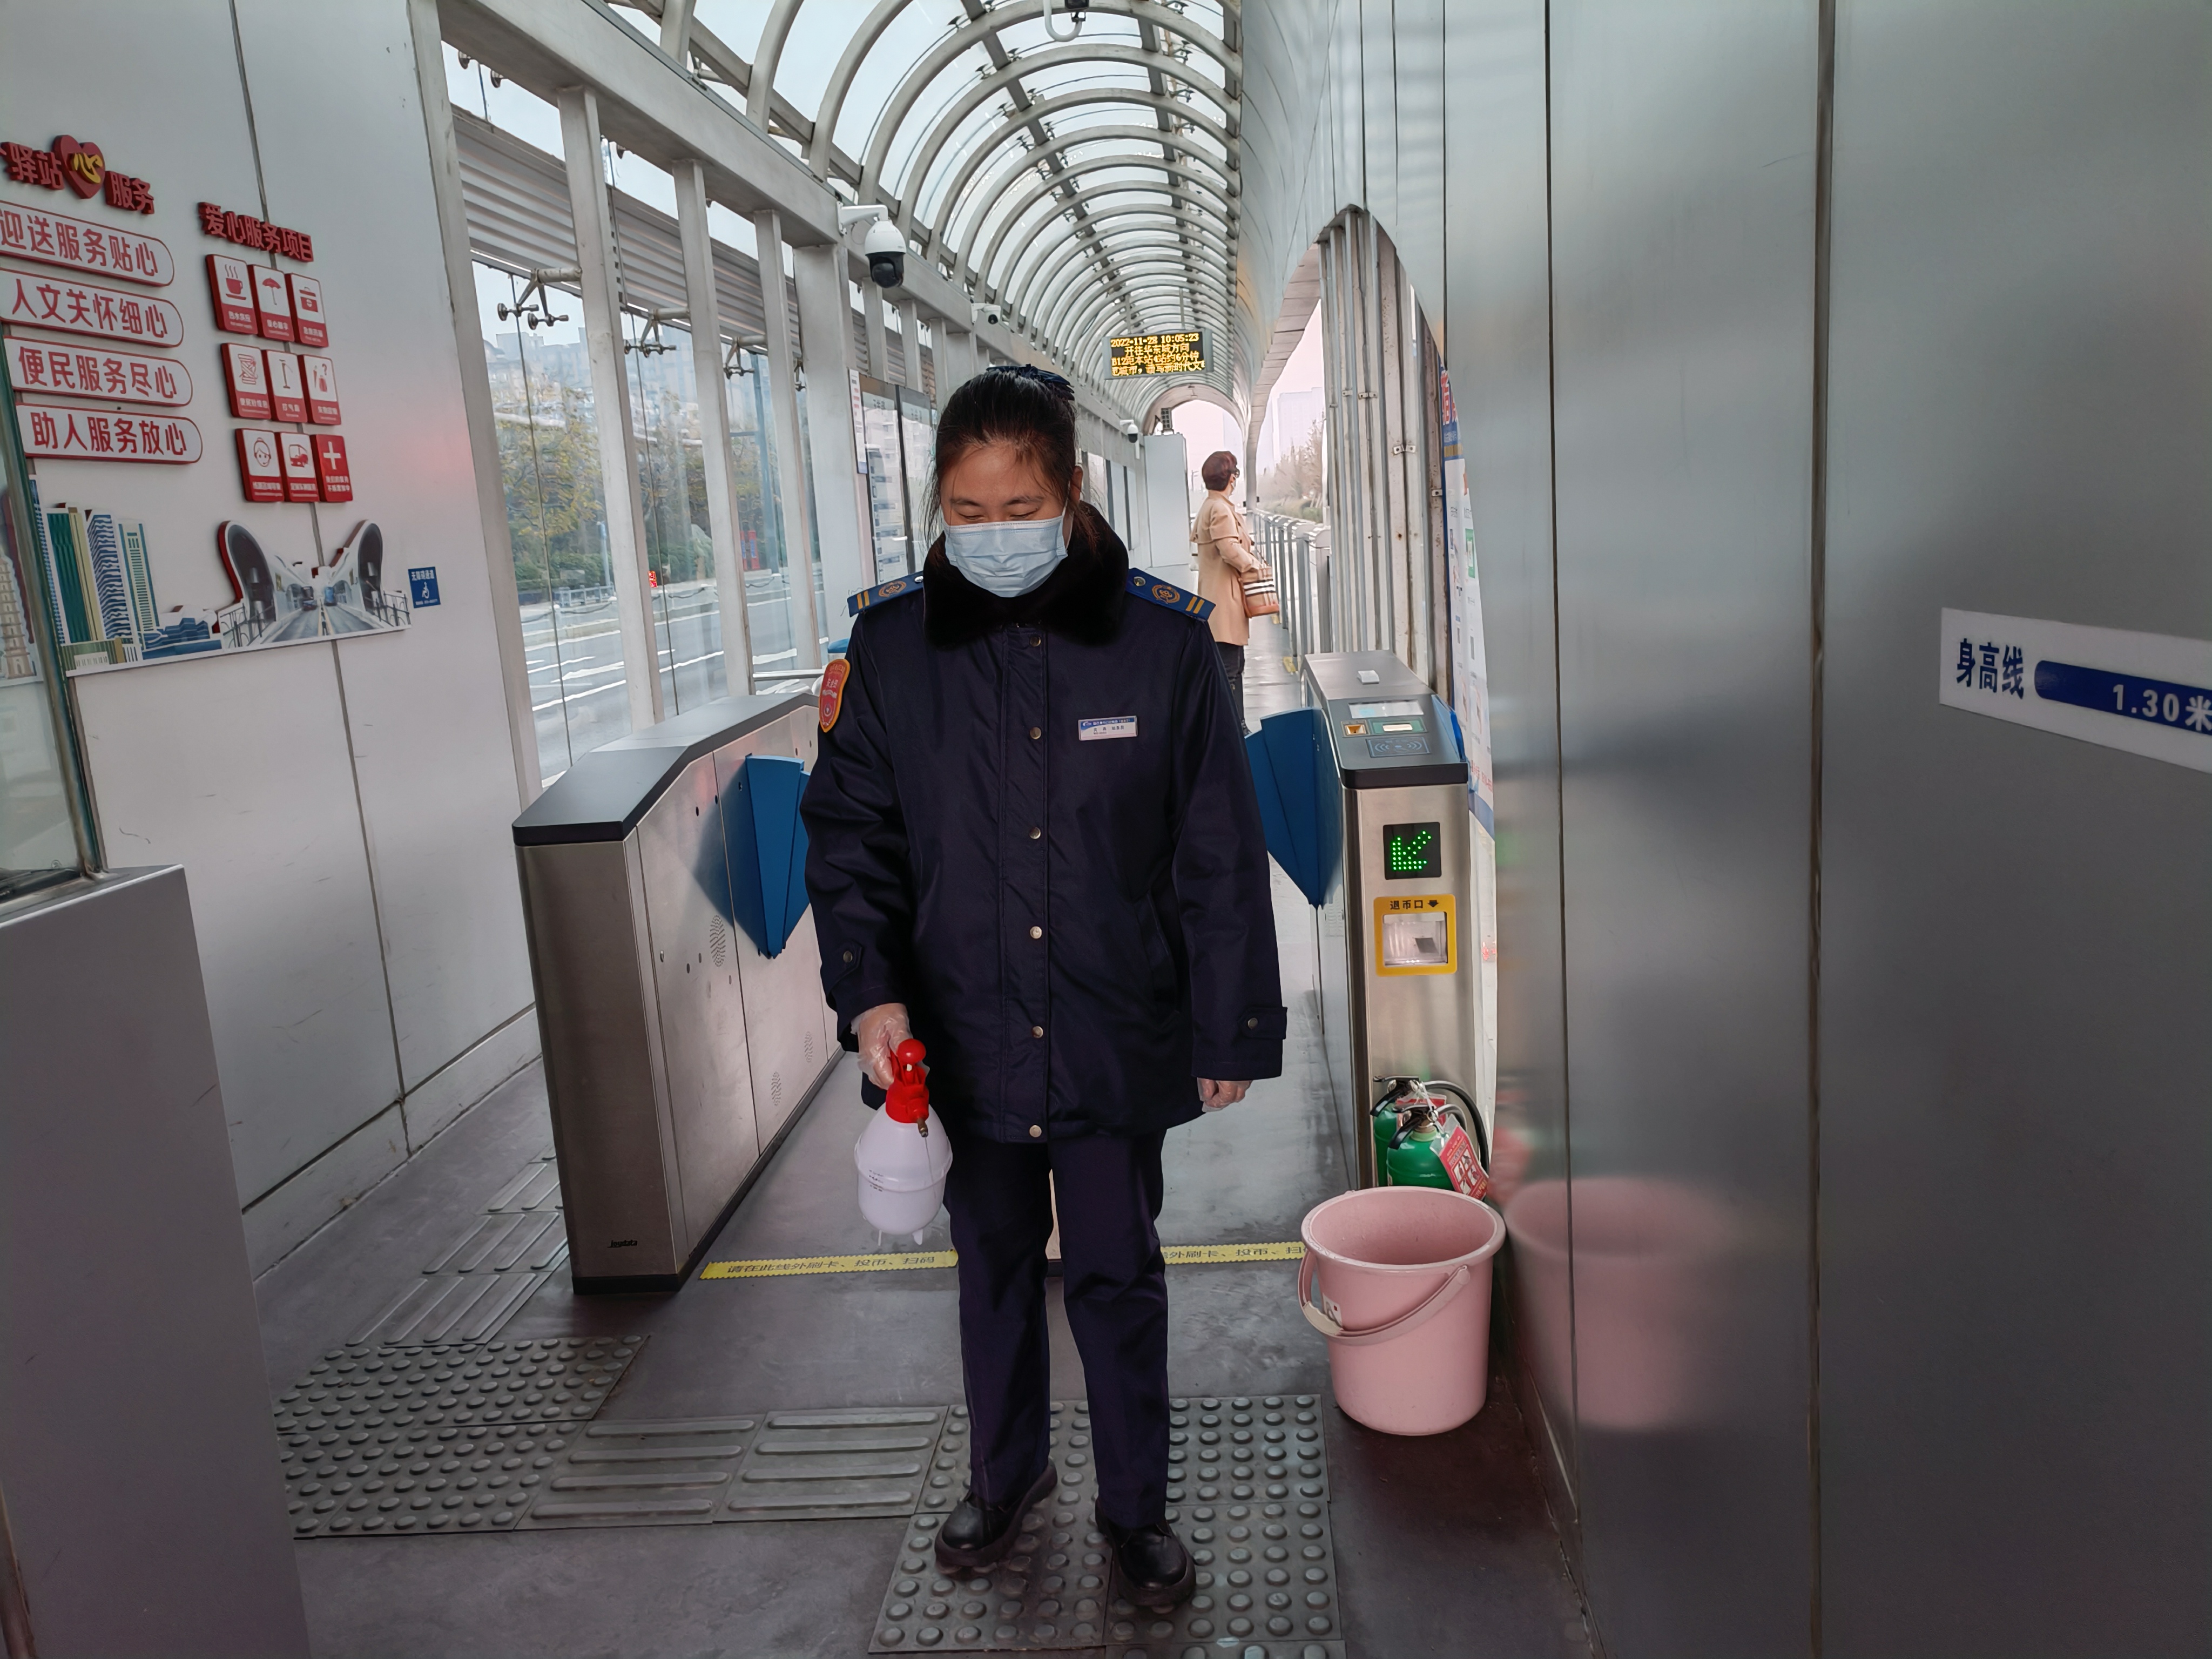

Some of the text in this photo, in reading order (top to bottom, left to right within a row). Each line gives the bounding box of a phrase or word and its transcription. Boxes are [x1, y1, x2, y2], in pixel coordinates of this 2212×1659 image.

[0, 141, 64, 191] 驿站
[106, 171, 155, 215] 服务
[0, 208, 158, 277] 迎送服务贴心
[199, 202, 314, 262] 爱心服务项目
[12, 278, 168, 339] 人文关怀细心
[1161, 333, 1199, 344] 10:05:23
[18, 346, 177, 399] 便民服务尽心
[30, 411, 187, 455] 助人服务放心
[1956, 638, 2212, 732] 身高线 1.30米
[1390, 900, 1423, 910] 退币口
